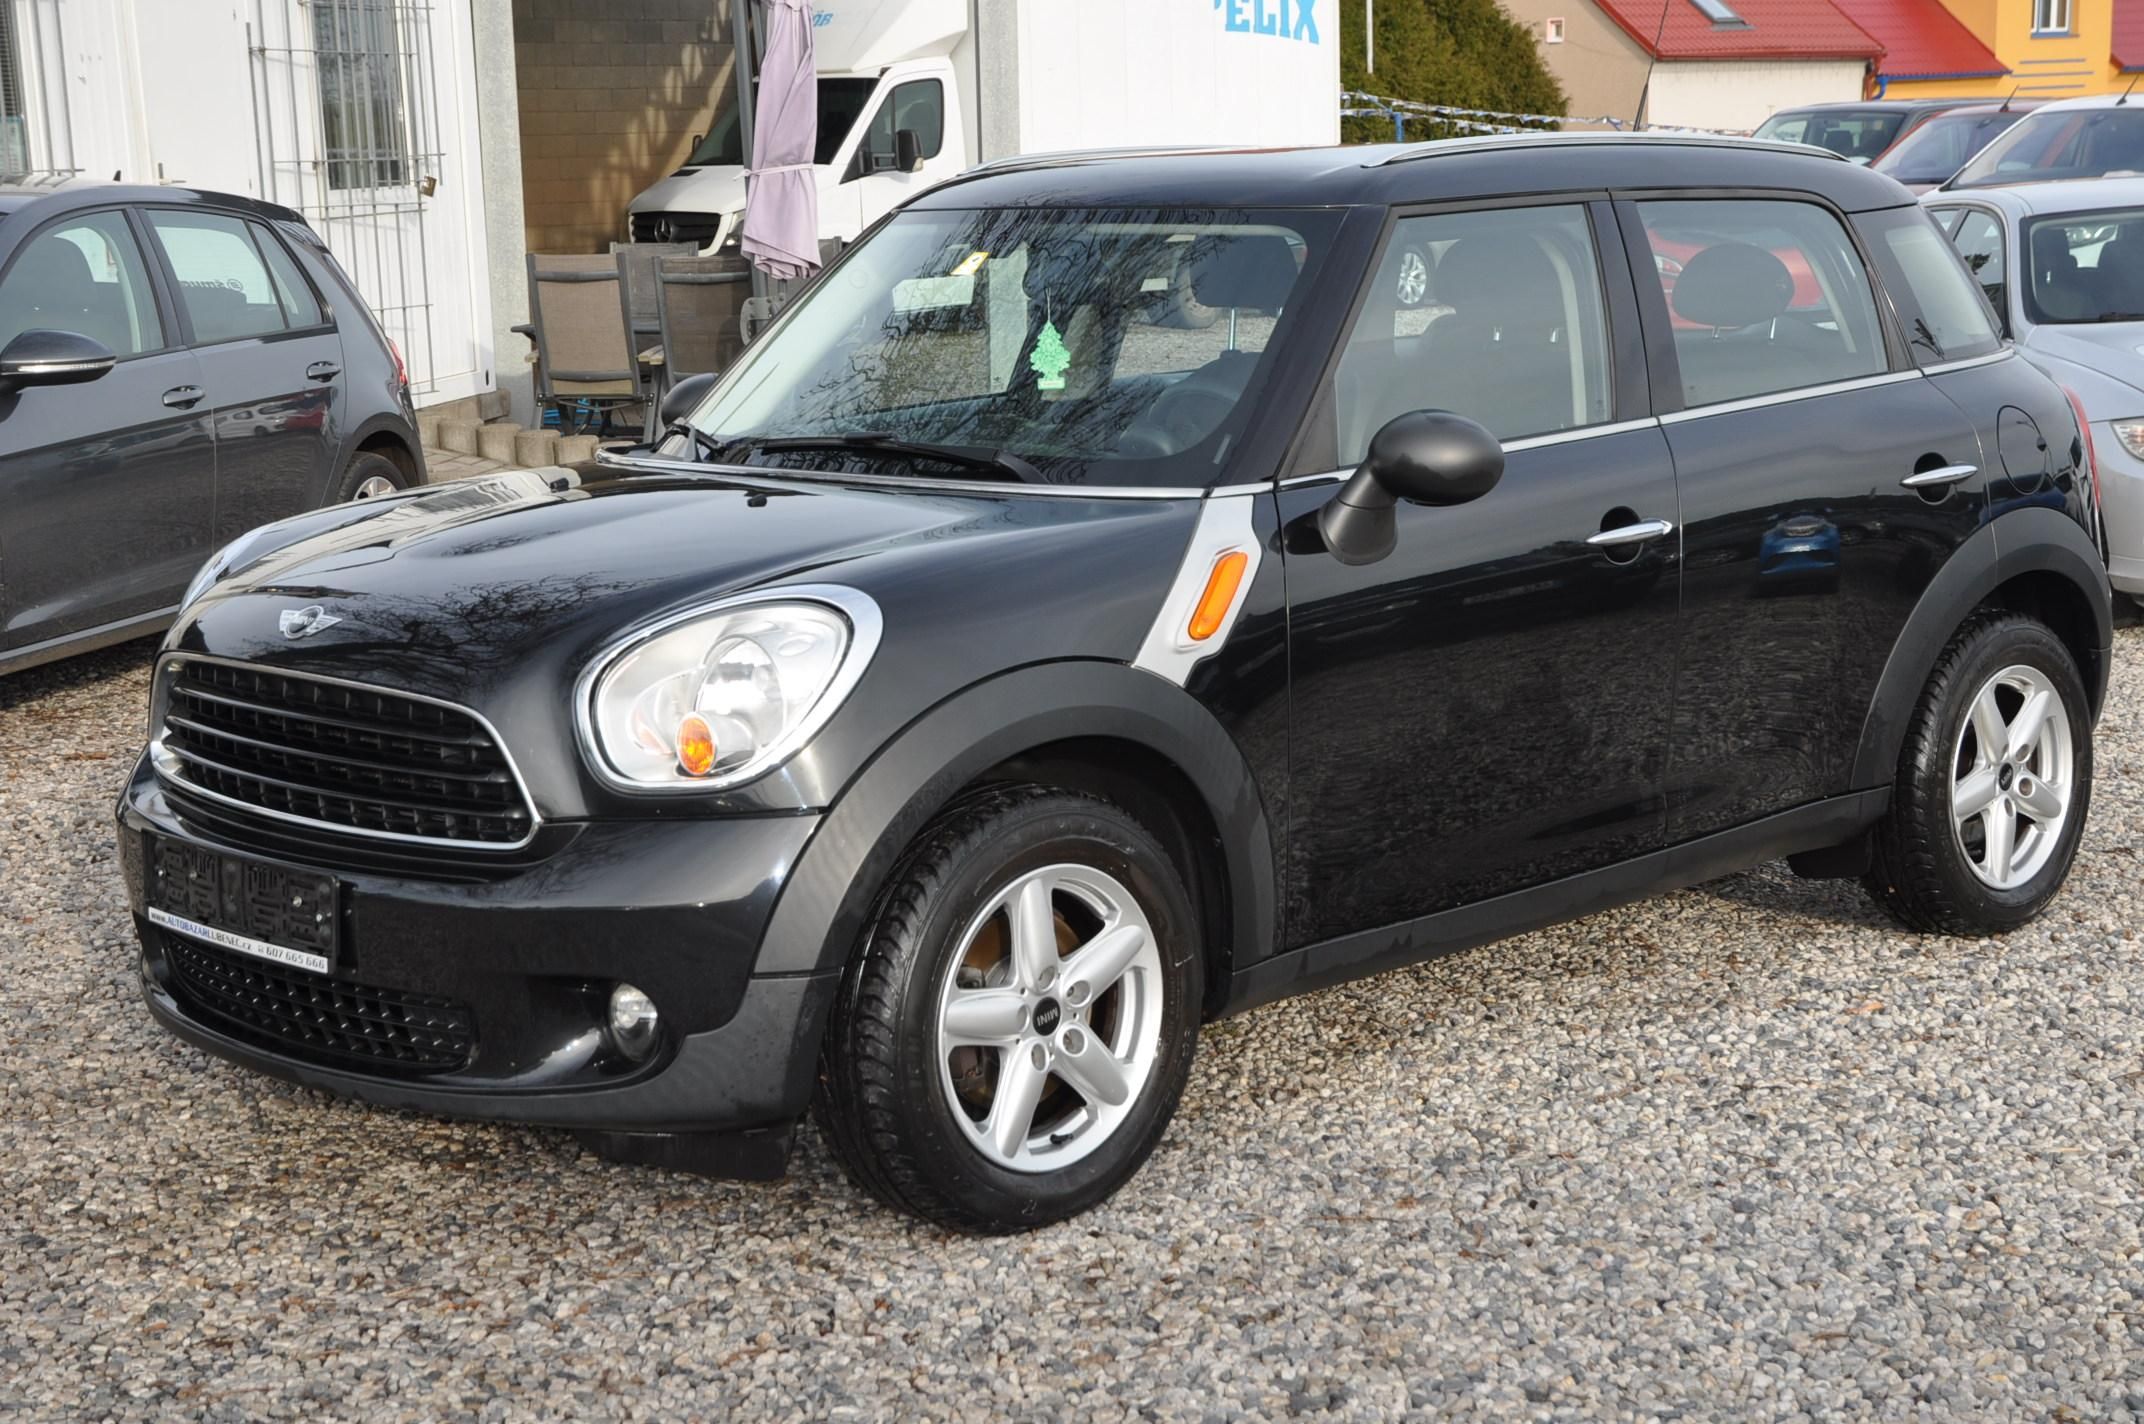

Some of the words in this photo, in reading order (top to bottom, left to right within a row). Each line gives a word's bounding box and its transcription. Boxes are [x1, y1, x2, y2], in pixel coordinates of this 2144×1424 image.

[1214, 0, 1319, 45] ELIX
[266, 947, 284, 959] 607
[286, 951, 304, 964] 665
[306, 956, 325, 969] 666
[1036, 1007, 1059, 1027] MINI
